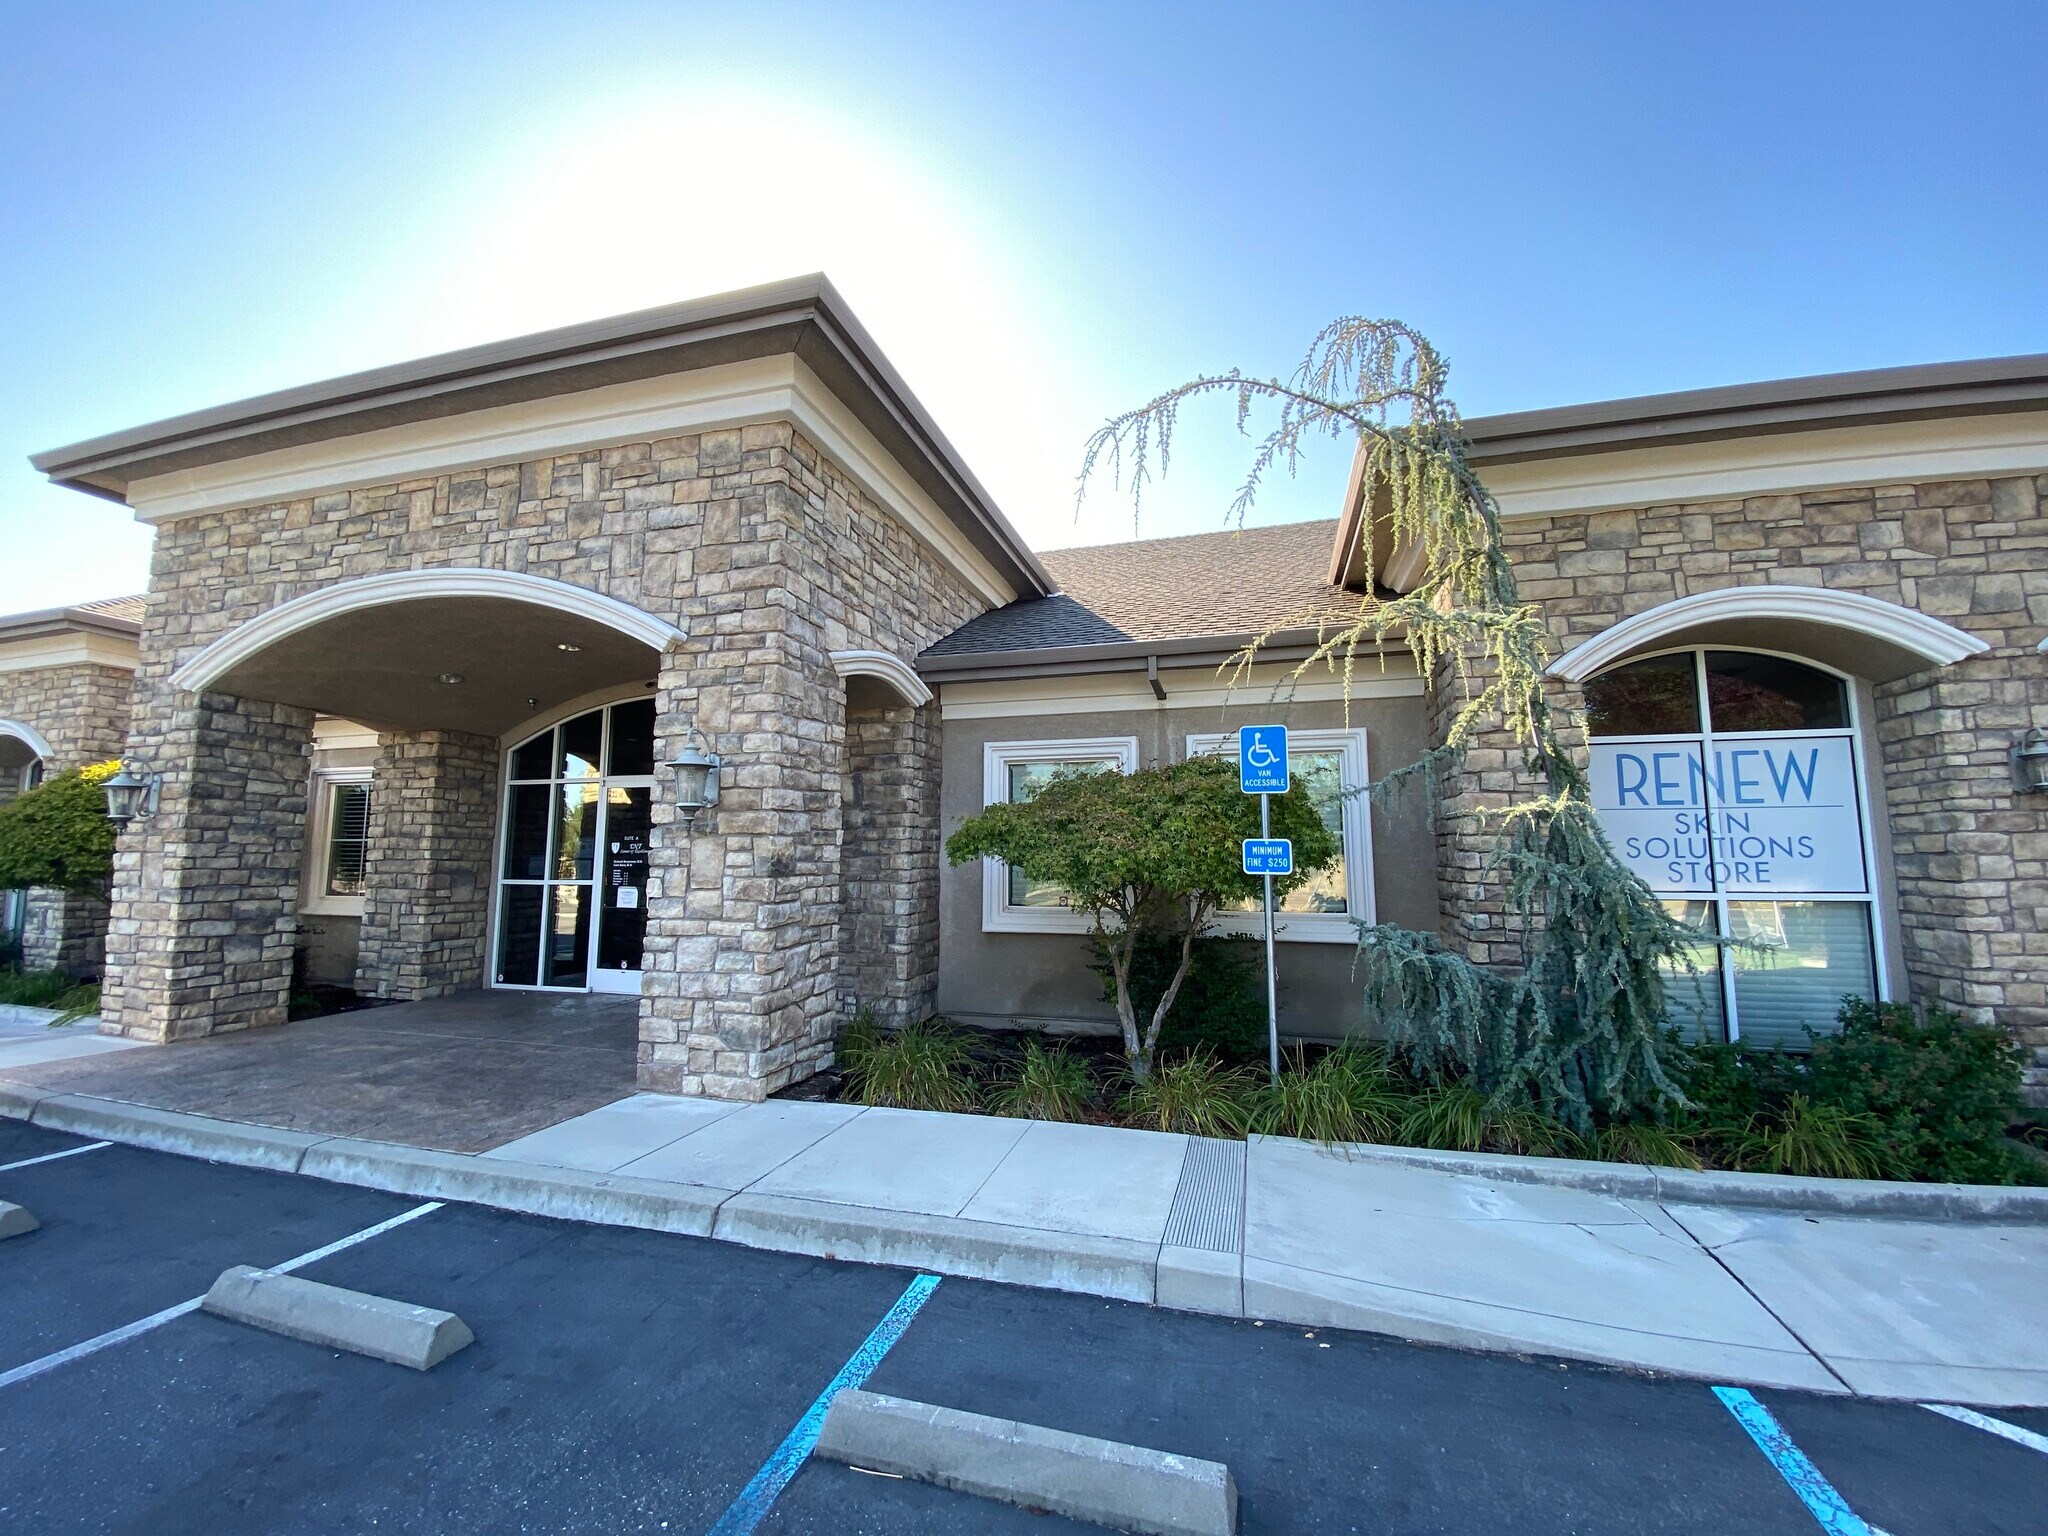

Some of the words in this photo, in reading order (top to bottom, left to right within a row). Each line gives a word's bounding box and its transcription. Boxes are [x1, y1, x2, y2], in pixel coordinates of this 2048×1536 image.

[1616, 748, 1818, 806] RENEW
[1675, 812, 1751, 834] SKIN
[1252, 846, 1283, 855] MINIMUM
[1626, 836, 1815, 859] SOLUTIONS
[1247, 857, 1262, 867] FINE
[1267, 857, 1288, 867] $250
[1668, 861, 1771, 883] STORE
